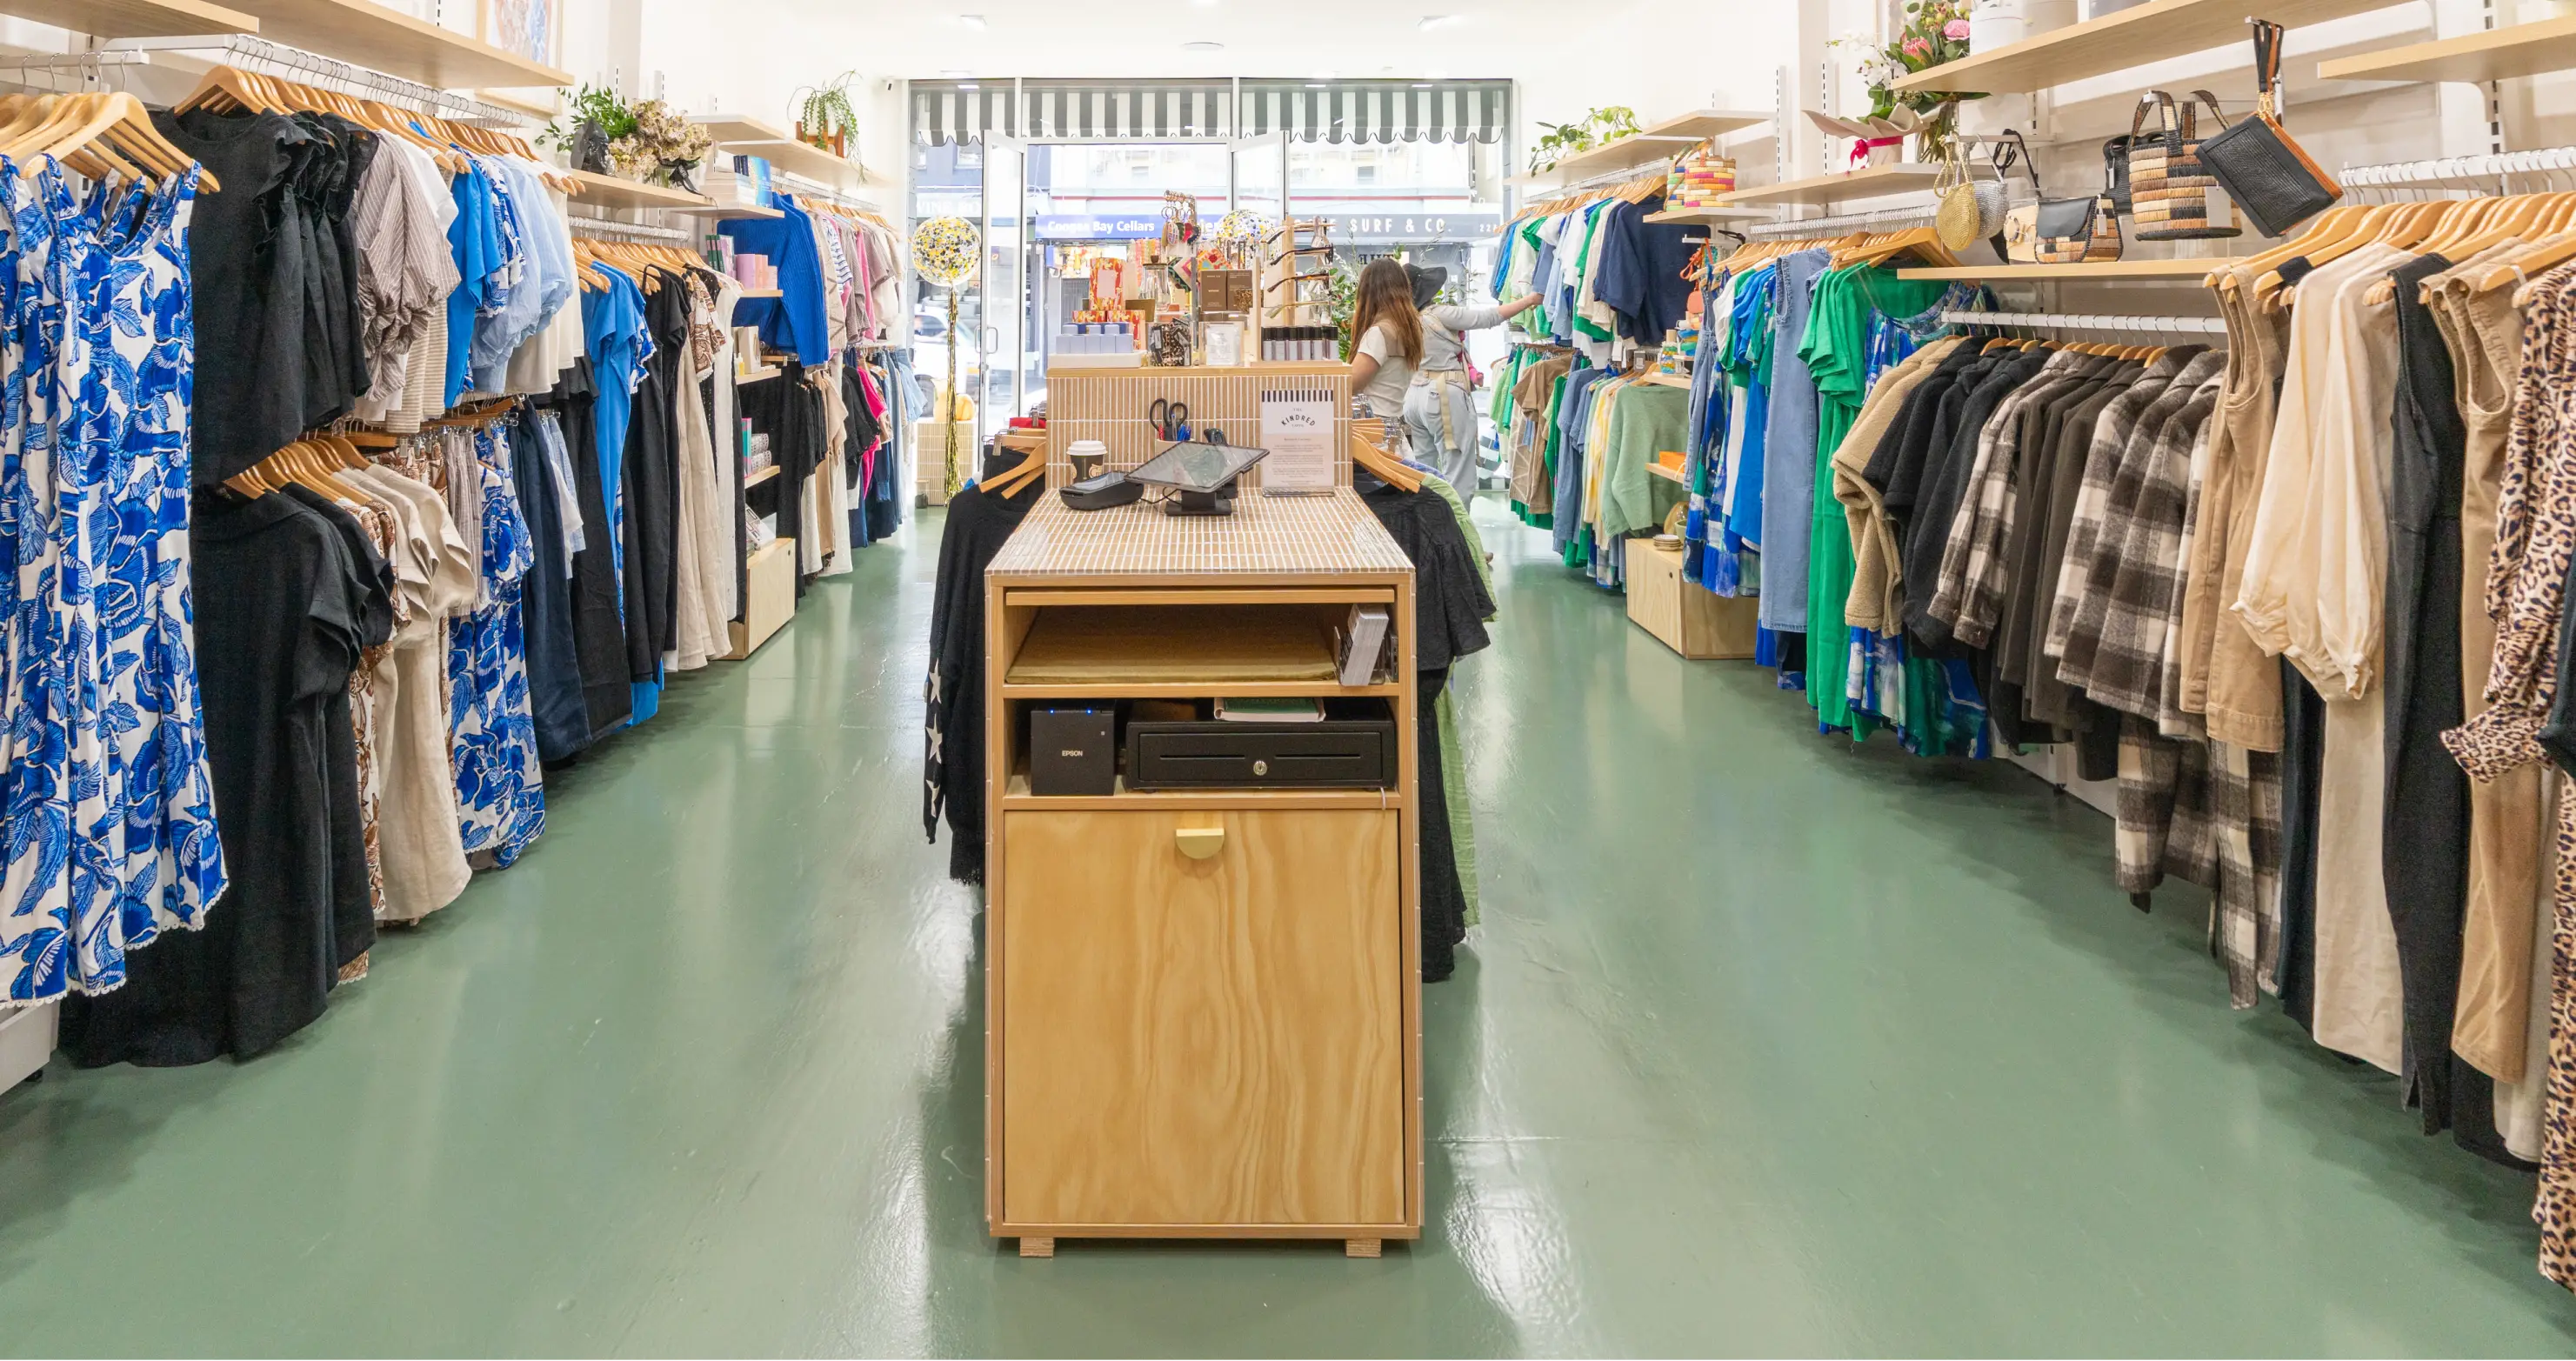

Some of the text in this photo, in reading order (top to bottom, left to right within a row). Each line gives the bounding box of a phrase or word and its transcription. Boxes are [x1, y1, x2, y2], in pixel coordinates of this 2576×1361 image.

[1092, 221, 1113, 234] Bay
[1117, 220, 1155, 231] Cellars
[1350, 217, 1393, 233] SURF
[1405, 217, 1415, 233] &
[1425, 217, 1452, 233] CO.
[1281, 415, 1315, 426] KINDRED
